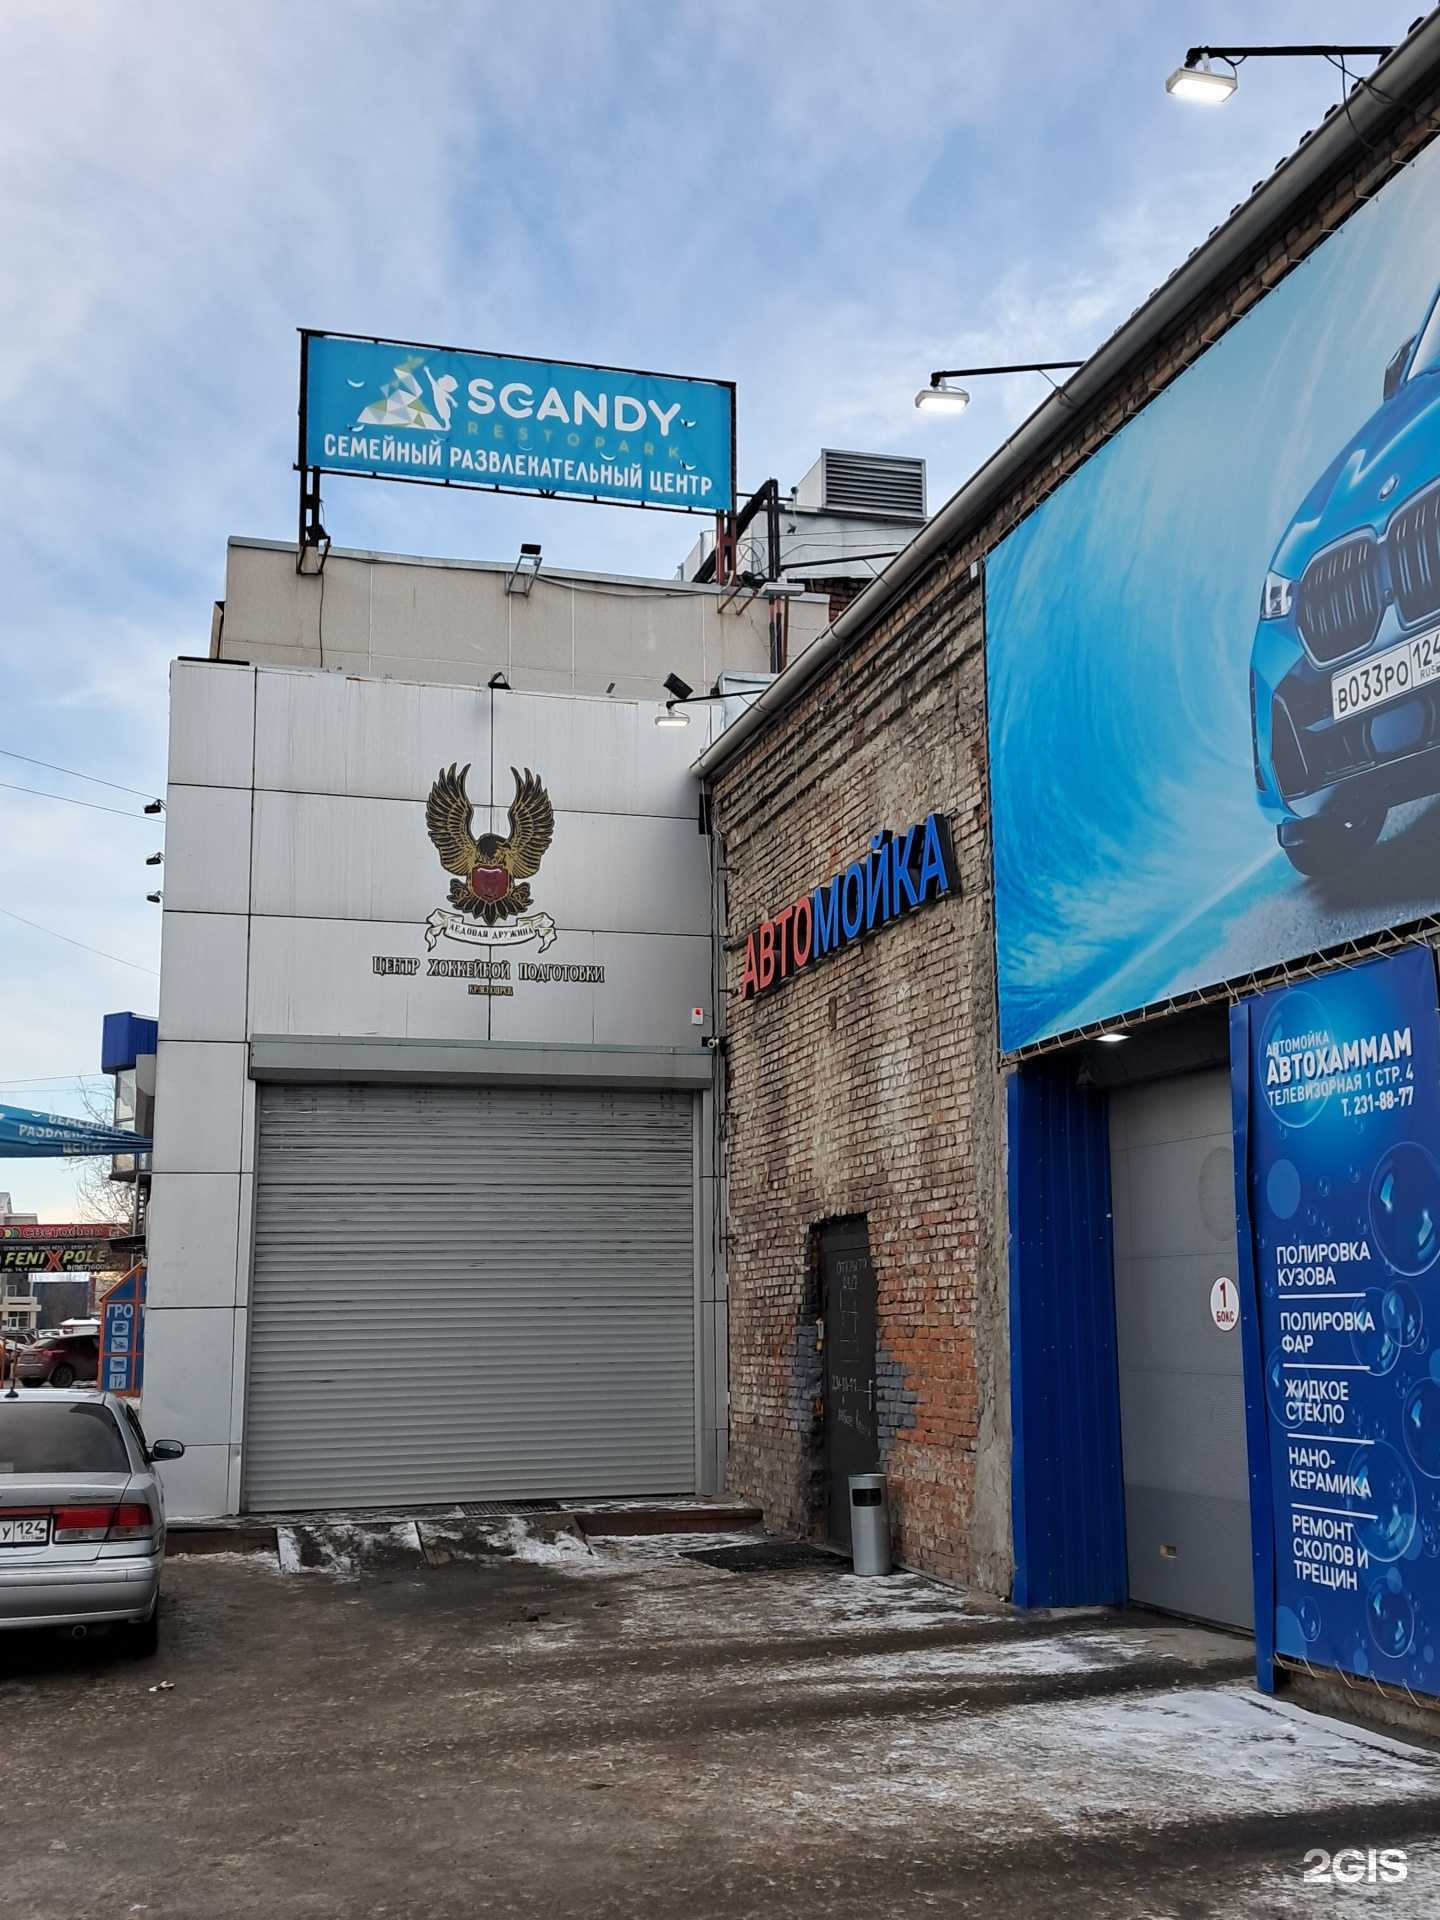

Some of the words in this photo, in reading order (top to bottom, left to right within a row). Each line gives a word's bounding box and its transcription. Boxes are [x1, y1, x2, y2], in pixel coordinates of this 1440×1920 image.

[467, 378, 681, 436] SCANDY
[324, 434, 441, 467] СЕМЕЙНЫЙ
[450, 447, 642, 490] РАЗВЛЕКАТЕЛЬНЫЙ
[650, 470, 712, 496] ЦЕНТР
[741, 811, 951, 999] АВТОМОЙКА
[373, 956, 420, 976] ЦЕНТР
[427, 958, 511, 980] ХОККЕЙНОЙ
[518, 962, 605, 983] ПОДГОТОВКИ
[1266, 1030, 1330, 1057] АВТОМОЙКА
[1266, 1027, 1412, 1086] АВТОХАММАМ
[1267, 1072, 1363, 1106] ТЕЛЕВИЗОРНАЯ
[1365, 1071, 1371, 1089] 1
[1375, 1065, 1402, 1087] СТР.
[1405, 1063, 1414, 1081] 4
[1353, 1086, 1414, 1116] 231-88-77
[1276, 1241, 1371, 1264] ПОЛИРОВКА
[1277, 1266, 1336, 1287] КУЗОВА
[1219, 1280, 1227, 1308] 1
[1216, 1310, 1235, 1323] БОКС
[1280, 1311, 1376, 1332] ПОЛИРОВКА
[1281, 1334, 1314, 1353] ФАР
[1284, 1379, 1349, 1402] ЖИДКОЕ
[1286, 1401, 1345, 1424] СТЕКЛО
[1288, 1446, 1336, 1470] НАНО-
[1290, 1469, 1372, 1498] КЕРАМИКА
[1292, 1514, 1354, 1542] РЕМОНТ
[1293, 1537, 1354, 1566] СКОЛОВ
[1358, 1550, 1369, 1569] И
[1294, 1560, 1358, 1592] ТРЕЩИН
